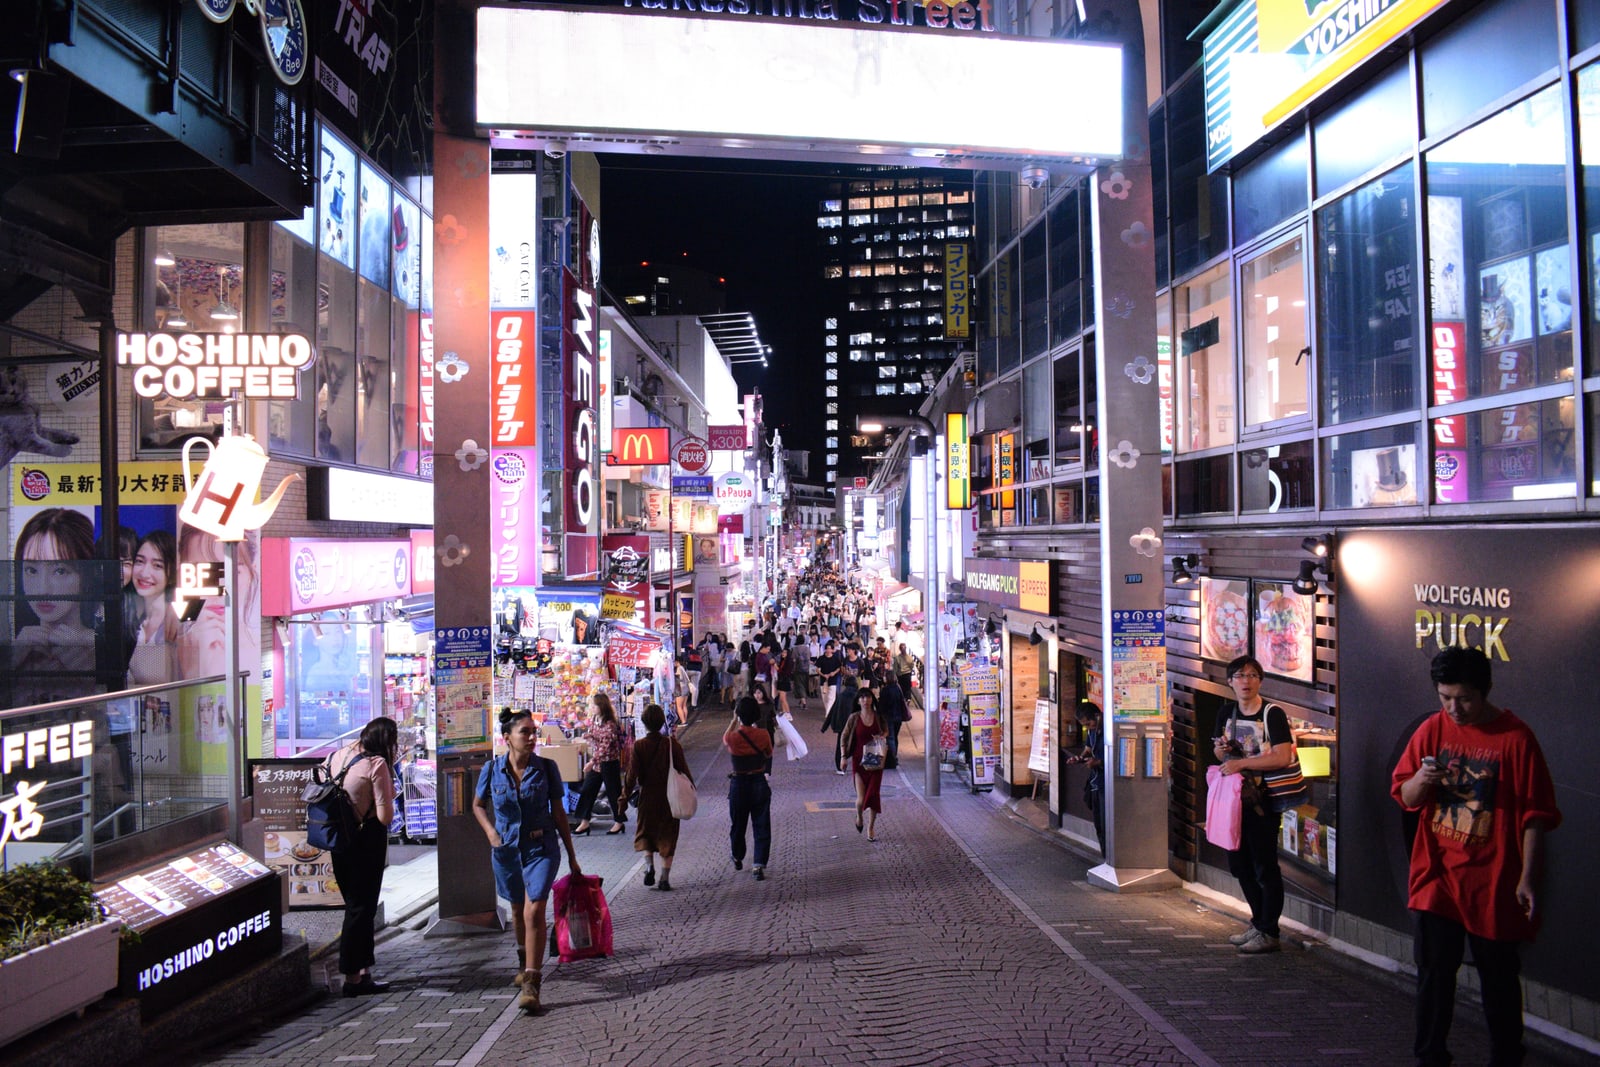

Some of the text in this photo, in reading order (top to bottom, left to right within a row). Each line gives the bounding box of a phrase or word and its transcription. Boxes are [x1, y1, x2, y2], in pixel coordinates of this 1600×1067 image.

[858, 0, 995, 32] Street
[948, 245, 967, 327] コインロッカー
[117, 333, 312, 367] HOSHINO
[56, 360, 100, 390] 猫カフ
[133, 366, 297, 398] COFFEE
[712, 436, 744, 449] ¥300
[680, 451, 705, 463] 消火栓
[58, 475, 199, 493] 最新リ大好評
[728, 486, 752, 498] Pausa
[191, 470, 245, 527] H
[966, 571, 1047, 597] WOLFGANG PUCK EXPRESS
[1413, 583, 1511, 609] WOLFGANG
[602, 608, 620, 617] HAPPY
[1415, 609, 1511, 662] PUCK
[611, 646, 651, 658] スクイー
[964, 674, 998, 682] EXCHANGE
[0, 719, 94, 775] FFEE
[263, 785, 305, 795] ハンドドリッ
[138, 910, 271, 991] HOSHINO COFFEE
